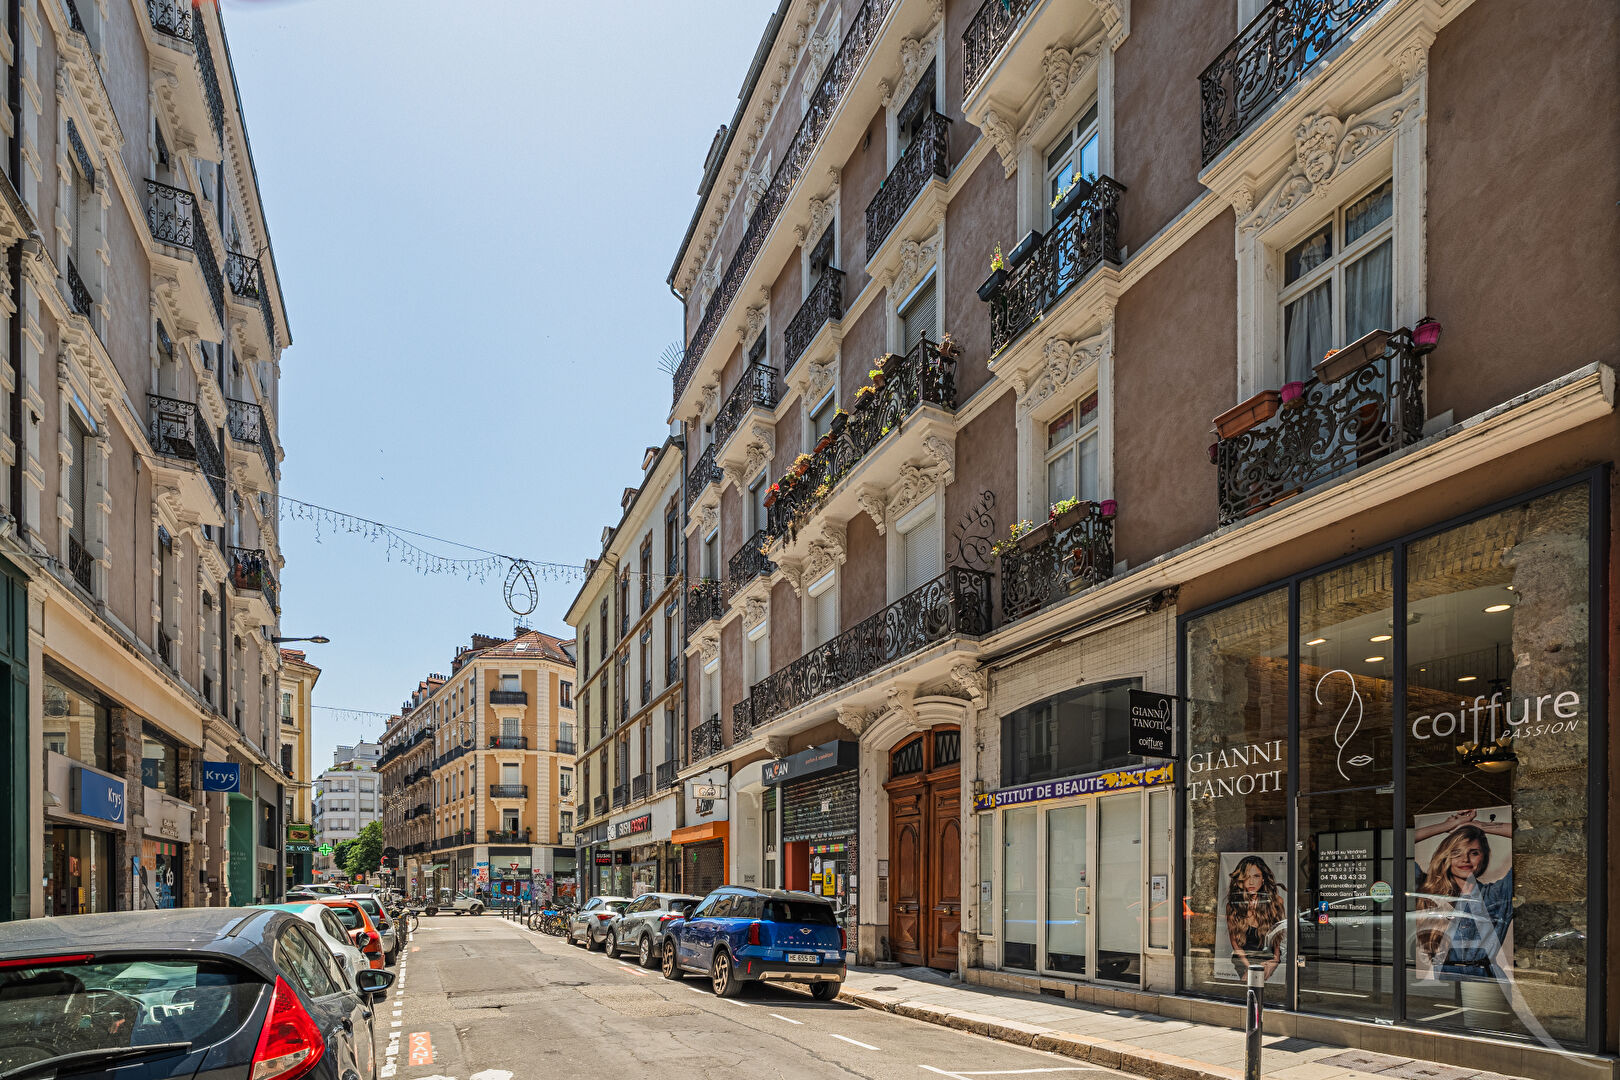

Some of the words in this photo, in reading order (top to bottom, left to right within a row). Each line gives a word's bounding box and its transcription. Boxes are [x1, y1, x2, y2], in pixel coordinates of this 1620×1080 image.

[1132, 706, 1163, 718] GIANNI
[1412, 691, 1580, 744] coiffure
[1132, 718, 1163, 730] TANOTI
[1500, 719, 1579, 740] PASSION
[1138, 737, 1164, 749] coiffure
[1188, 740, 1282, 773] GIANNI
[206, 770, 235, 784] Krys
[1187, 770, 1282, 800] TANOTI
[107, 787, 122, 808] Krys
[984, 787, 1034, 807] INSTITUT
[1036, 785, 1052, 797] DE
[1055, 777, 1104, 796] BEAUTE
